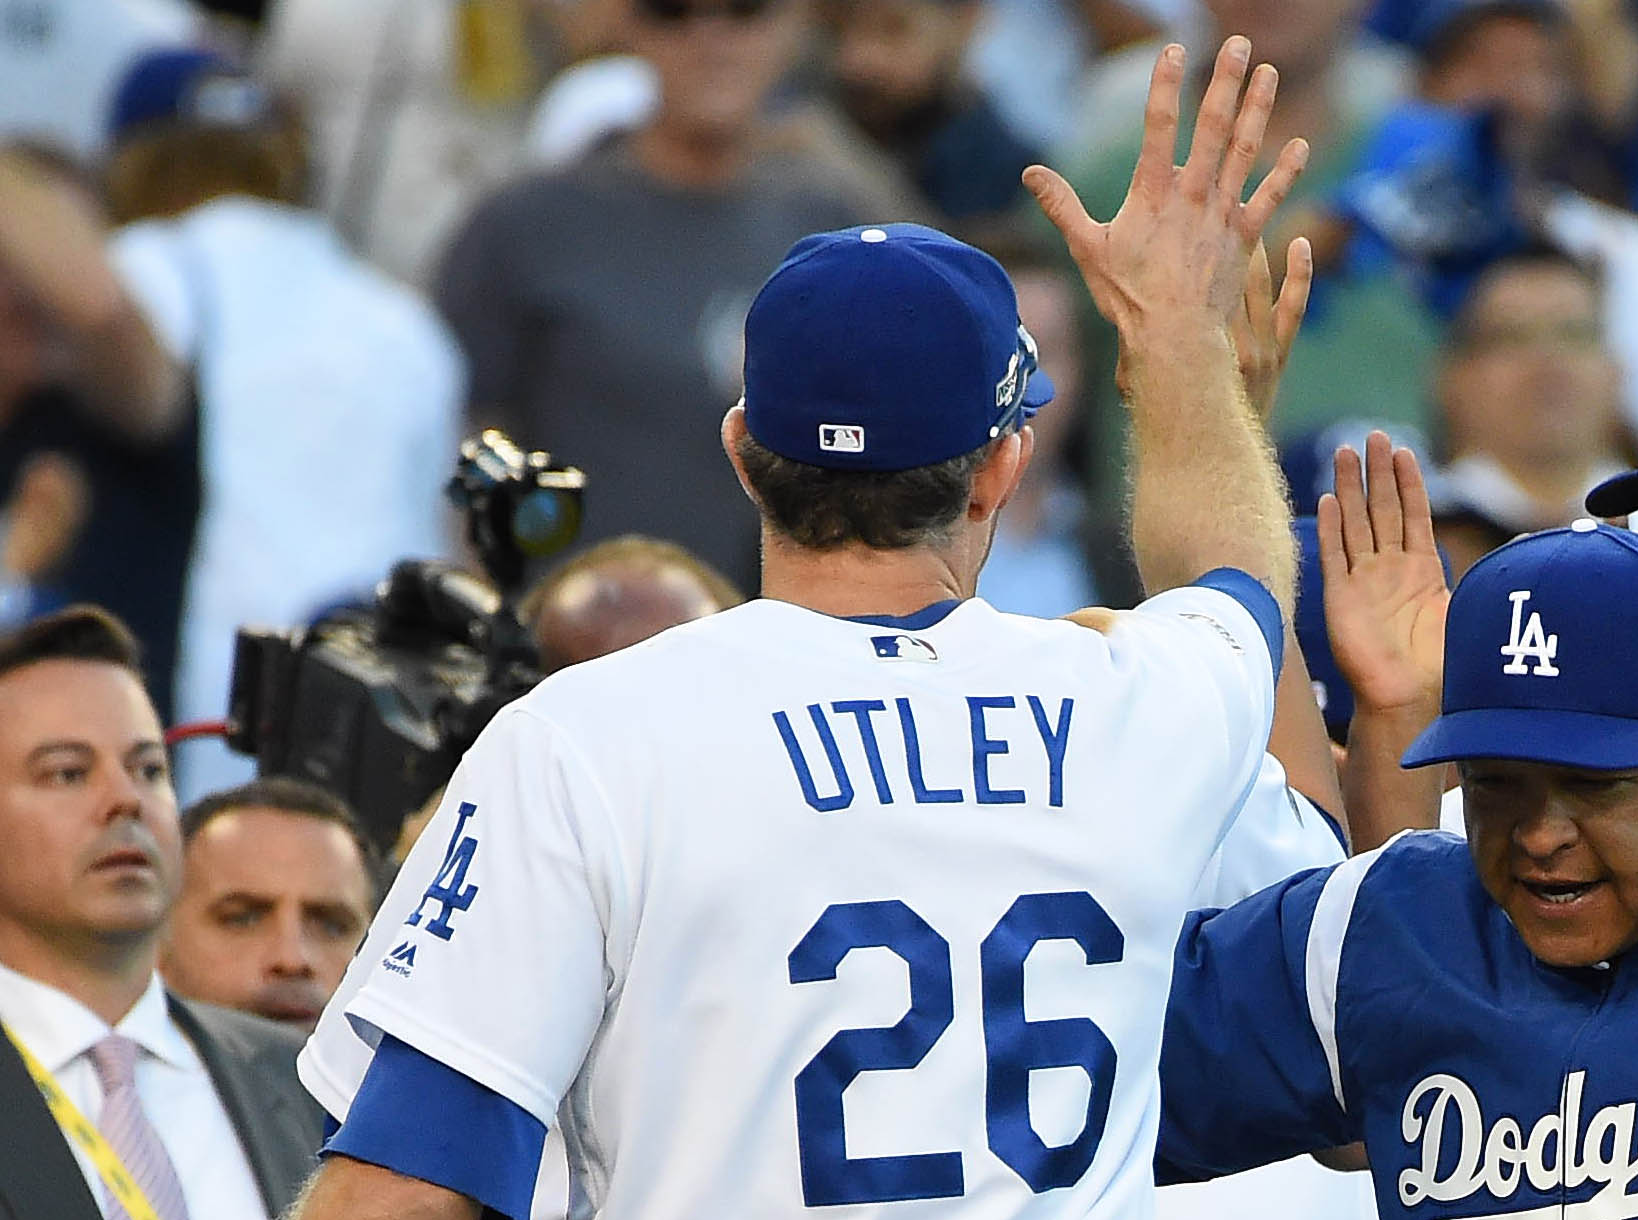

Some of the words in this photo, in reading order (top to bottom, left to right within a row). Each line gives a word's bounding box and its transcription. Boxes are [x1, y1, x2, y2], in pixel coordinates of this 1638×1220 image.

[1500, 590, 1560, 677] LA
[772, 695, 1075, 812] UTLEY
[404, 801, 478, 941] LA
[787, 891, 1125, 1208] 26
